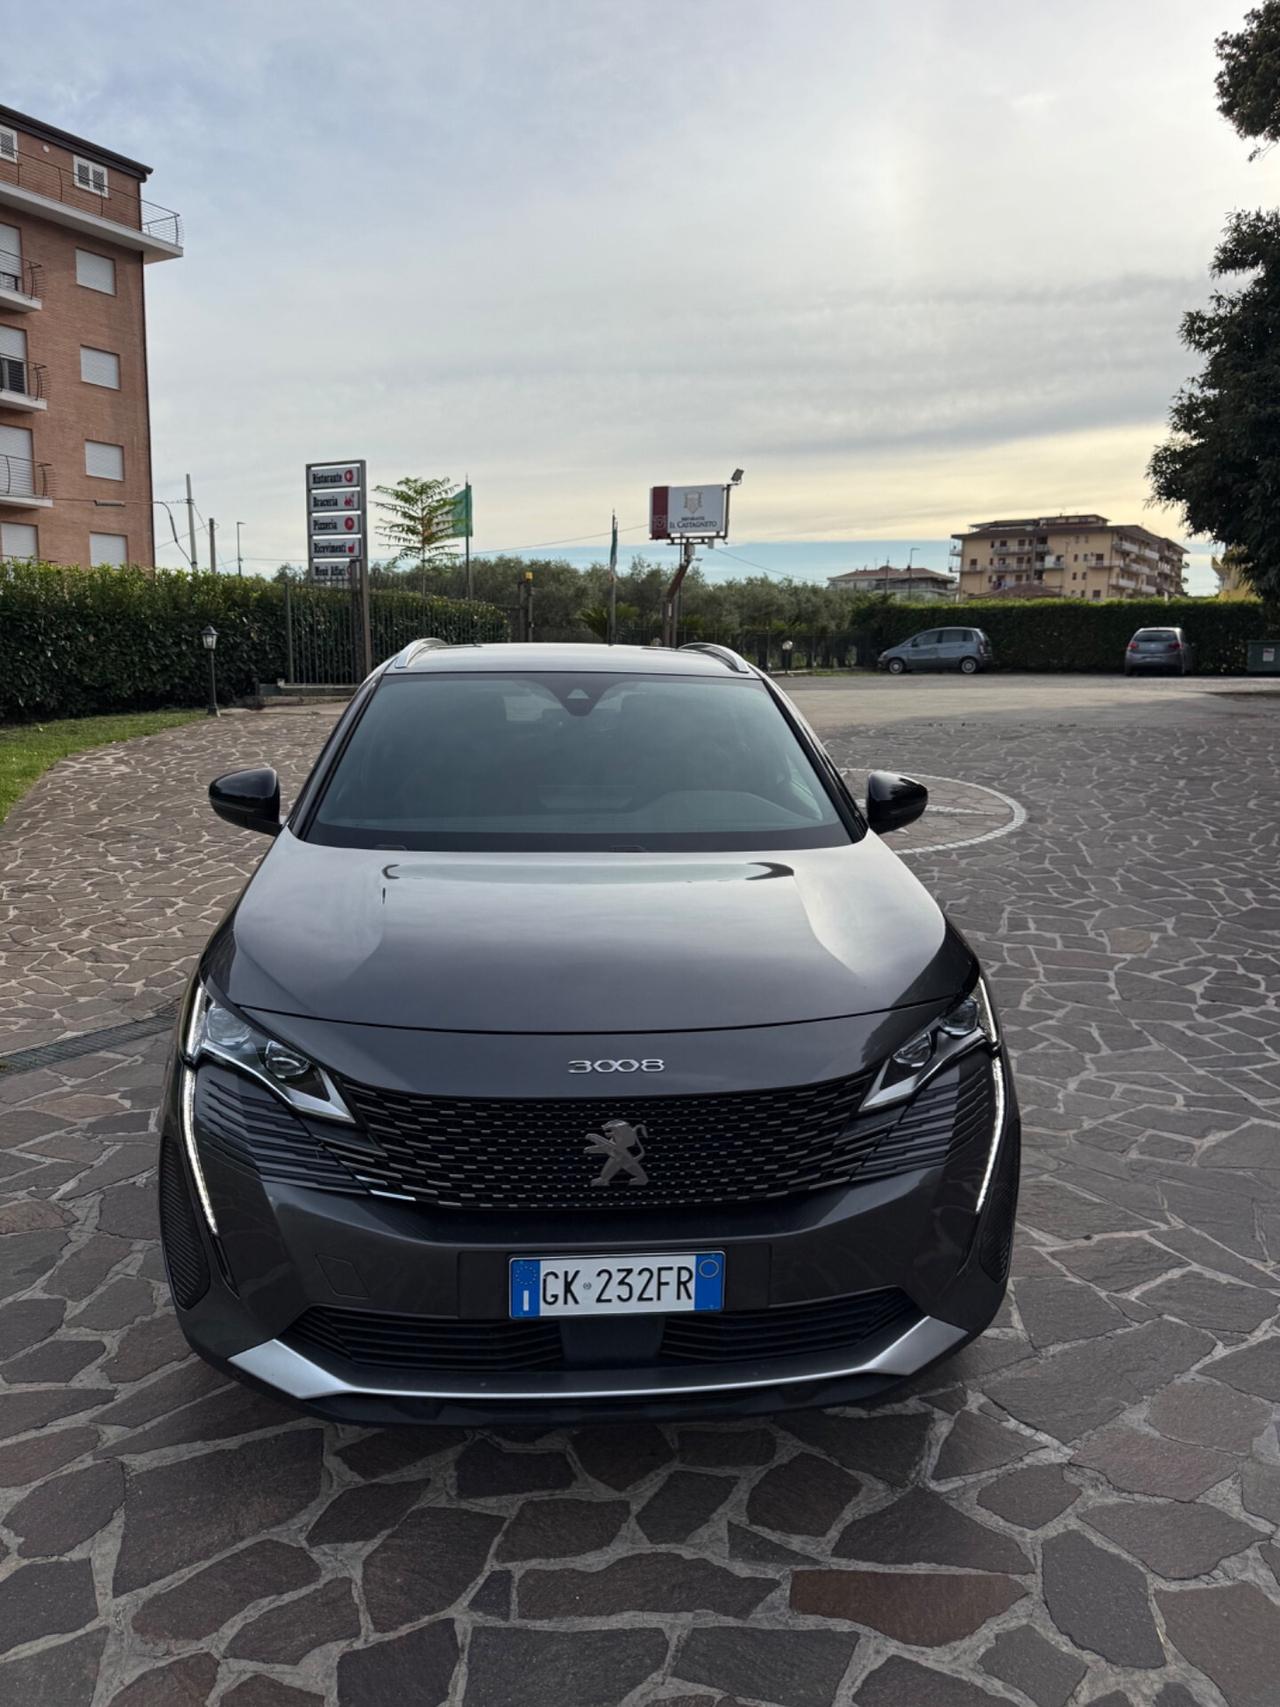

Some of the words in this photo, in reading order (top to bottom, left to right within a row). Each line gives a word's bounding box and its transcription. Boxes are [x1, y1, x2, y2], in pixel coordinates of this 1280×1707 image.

[312, 472, 342, 484] Ristorante
[313, 496, 338, 507] Braceria
[313, 519, 337, 531] Pizzeria
[568, 1059, 665, 1073] 3008
[542, 1270, 580, 1306] GK
[595, 1266, 693, 1303] 232FR
